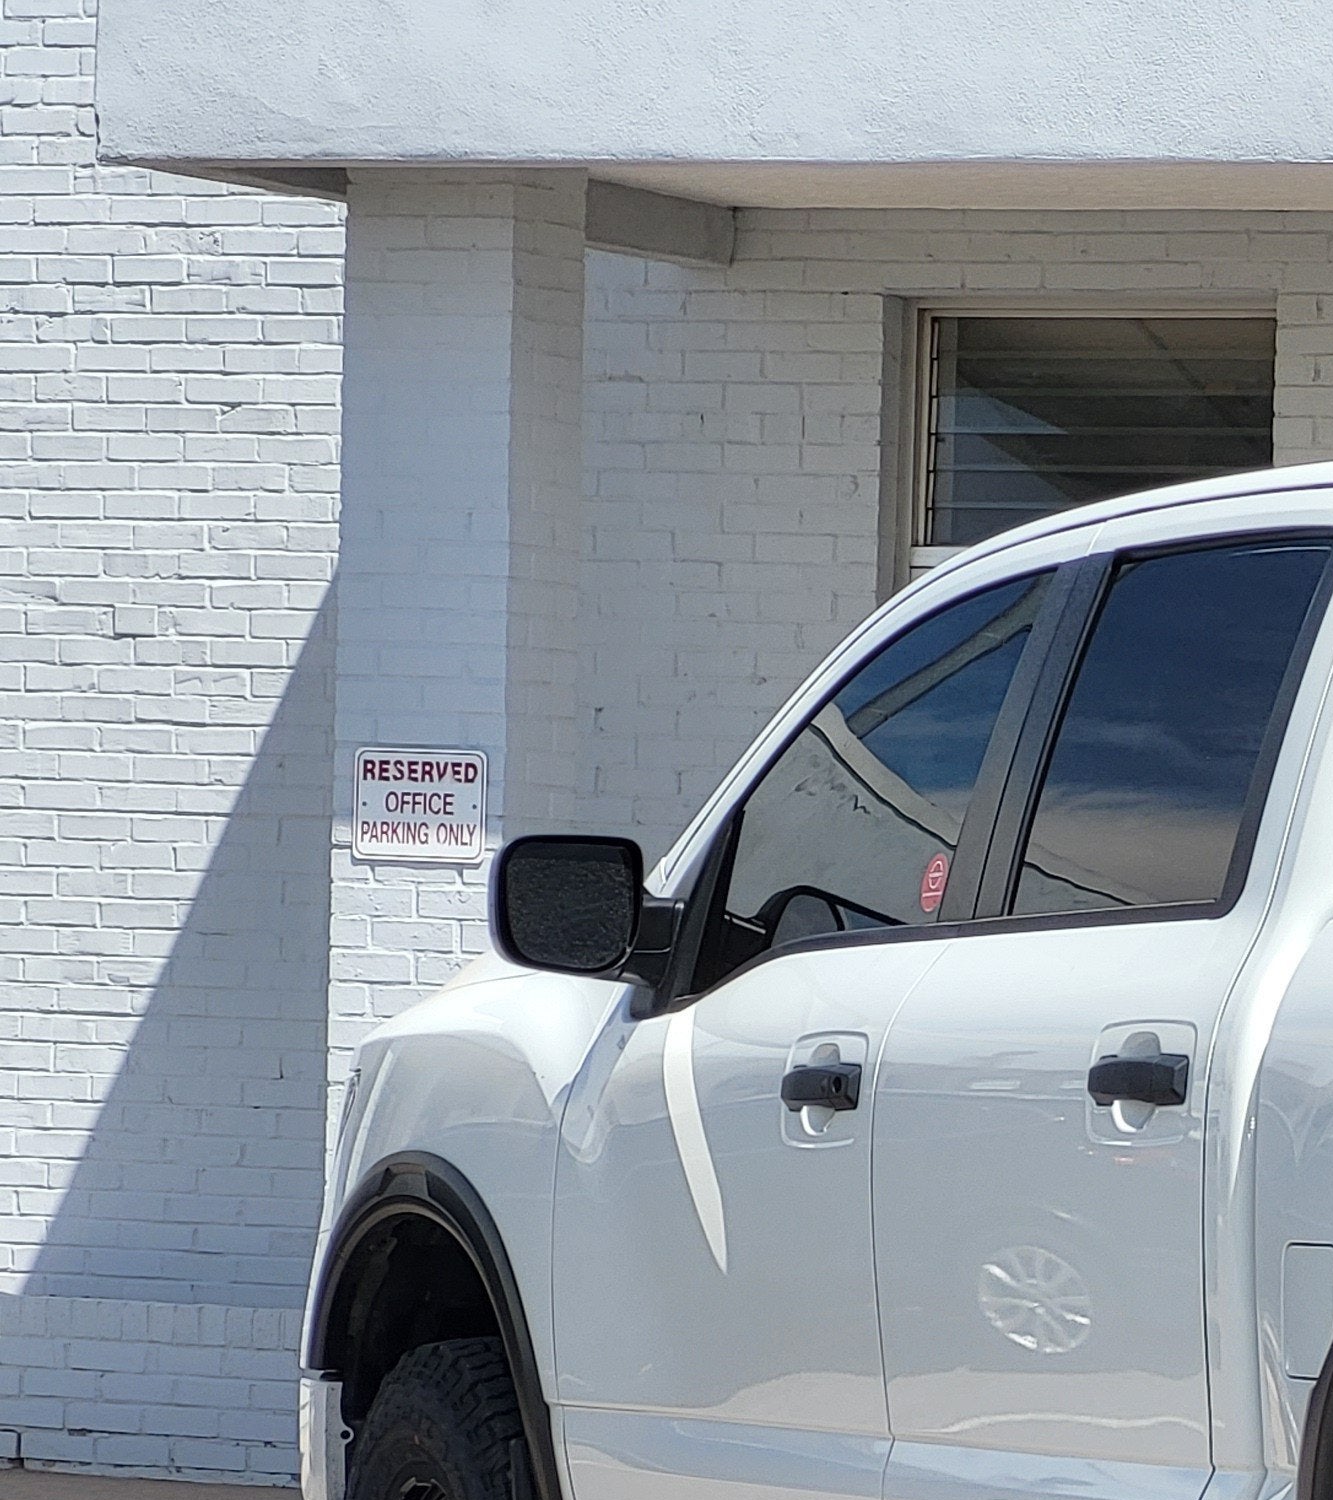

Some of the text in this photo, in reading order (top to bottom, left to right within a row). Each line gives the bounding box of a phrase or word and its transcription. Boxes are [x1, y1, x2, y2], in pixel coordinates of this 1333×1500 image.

[362, 759, 478, 783] RESERVED
[385, 791, 455, 815] OFFICE
[360, 821, 477, 847] PARKING ONLY
